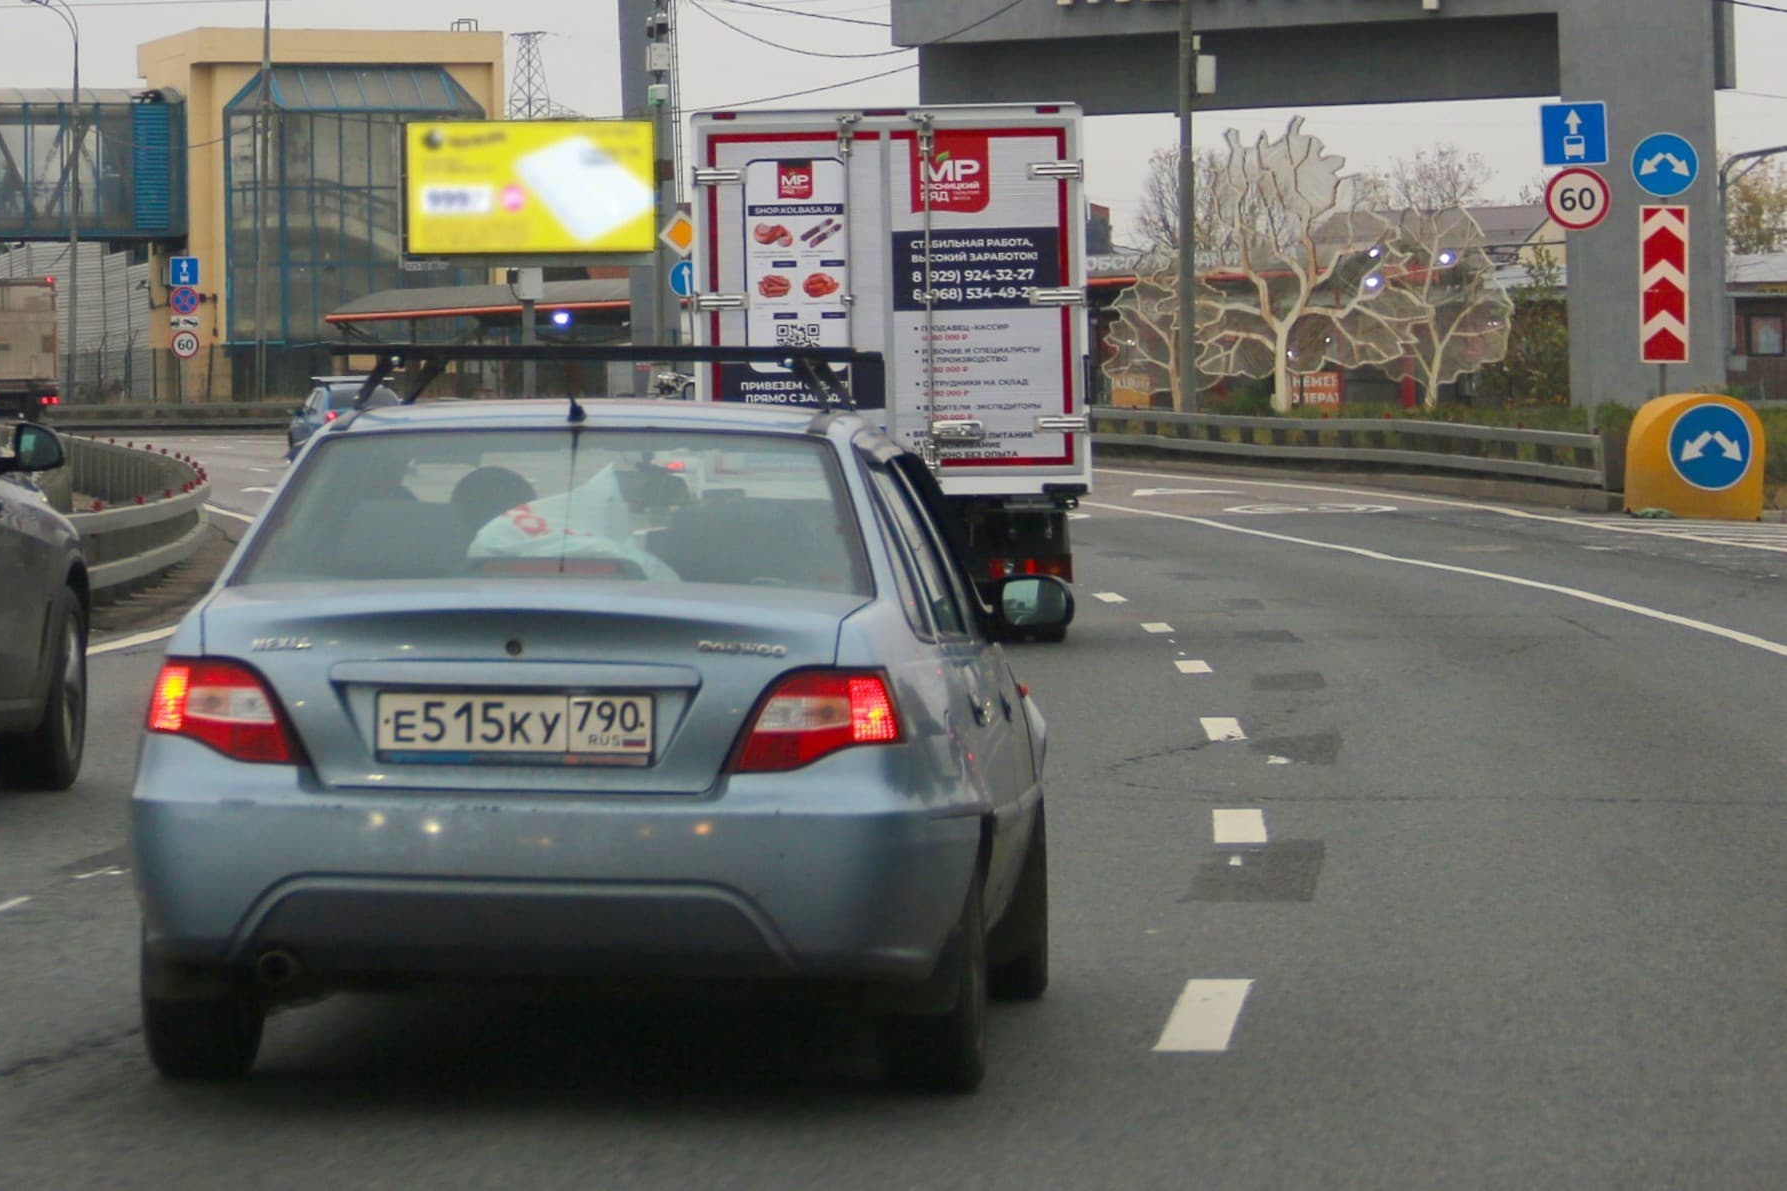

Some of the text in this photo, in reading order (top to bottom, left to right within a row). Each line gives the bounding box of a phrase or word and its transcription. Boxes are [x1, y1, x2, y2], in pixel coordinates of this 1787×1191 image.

[1560, 187, 1596, 212] 60
[755, 206, 837, 215] SHOP.KOLBASA.RU
[910, 238, 1034, 249] СТБИЛЬНАЯ РАБОТА,
[969, 251, 1038, 262] ЗАРАБОТОК!
[931, 270, 961, 284] 929)
[964, 268, 1035, 281] 924-32-27
[930, 288, 963, 302] 968)
[921, 324, 970, 332] ПОДАВЕЦ
[177, 339, 194, 351] 60
[740, 381, 802, 391] ПРИВЕЗЕМ
[923, 379, 981, 387] СТРУДНИКИ
[746, 394, 788, 403] ПРЯМО
[572, 700, 641, 733] 790
[588, 734, 621, 747] RUS
